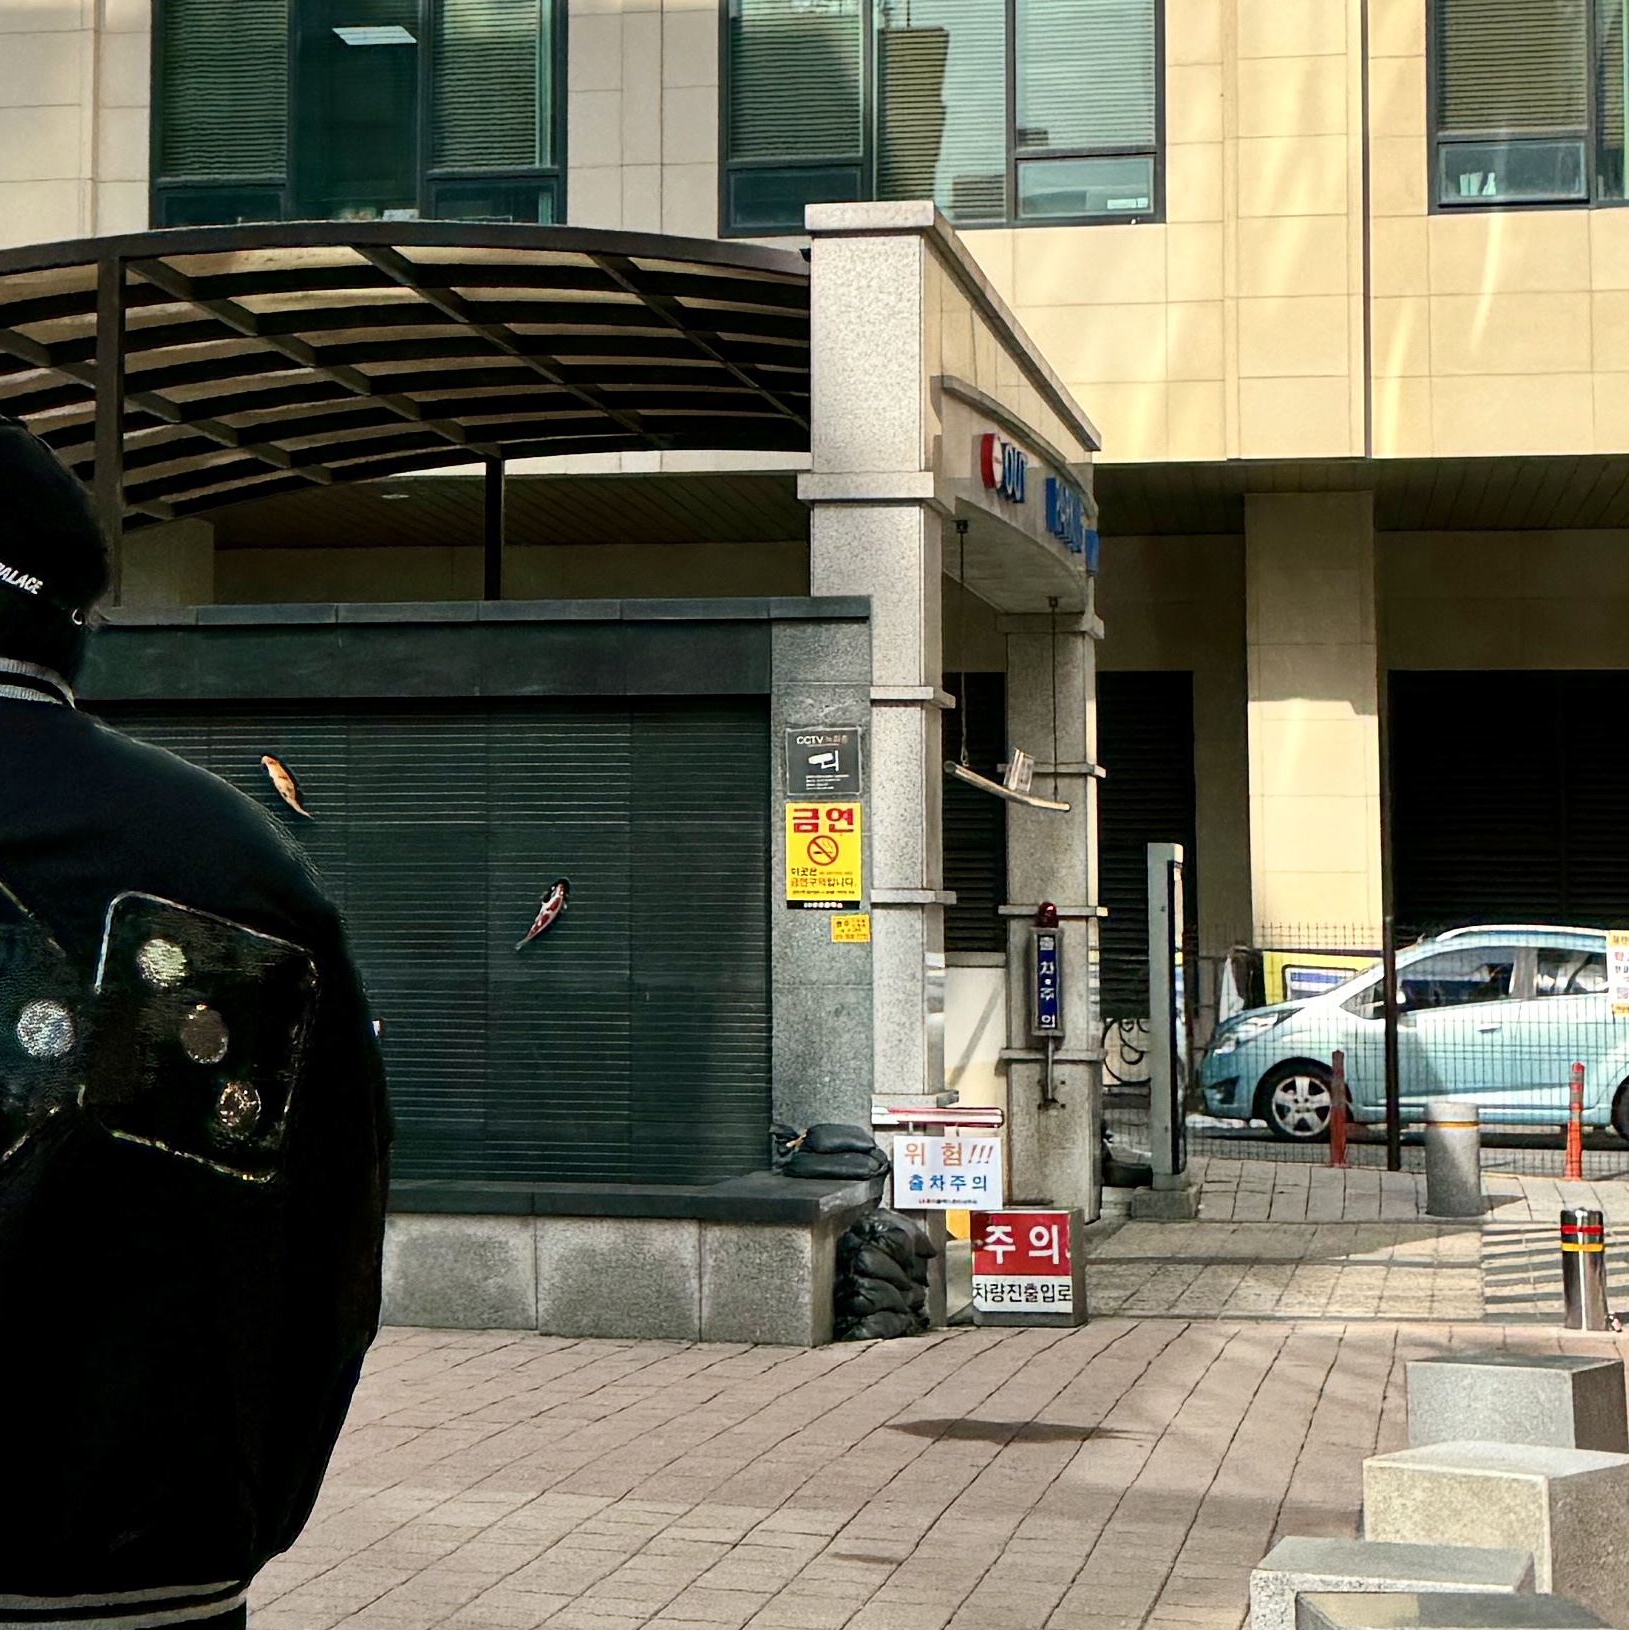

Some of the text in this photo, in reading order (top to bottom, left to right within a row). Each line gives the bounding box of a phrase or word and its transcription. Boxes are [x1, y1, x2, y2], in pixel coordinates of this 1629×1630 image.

[796, 735, 824, 745] CCTV
[792, 807, 855, 833] 금연
[909, 1174, 987, 1192] 출차주의
[983, 1224, 1060, 1265] 주의
[973, 1283, 1072, 1303] 차량진출입로
